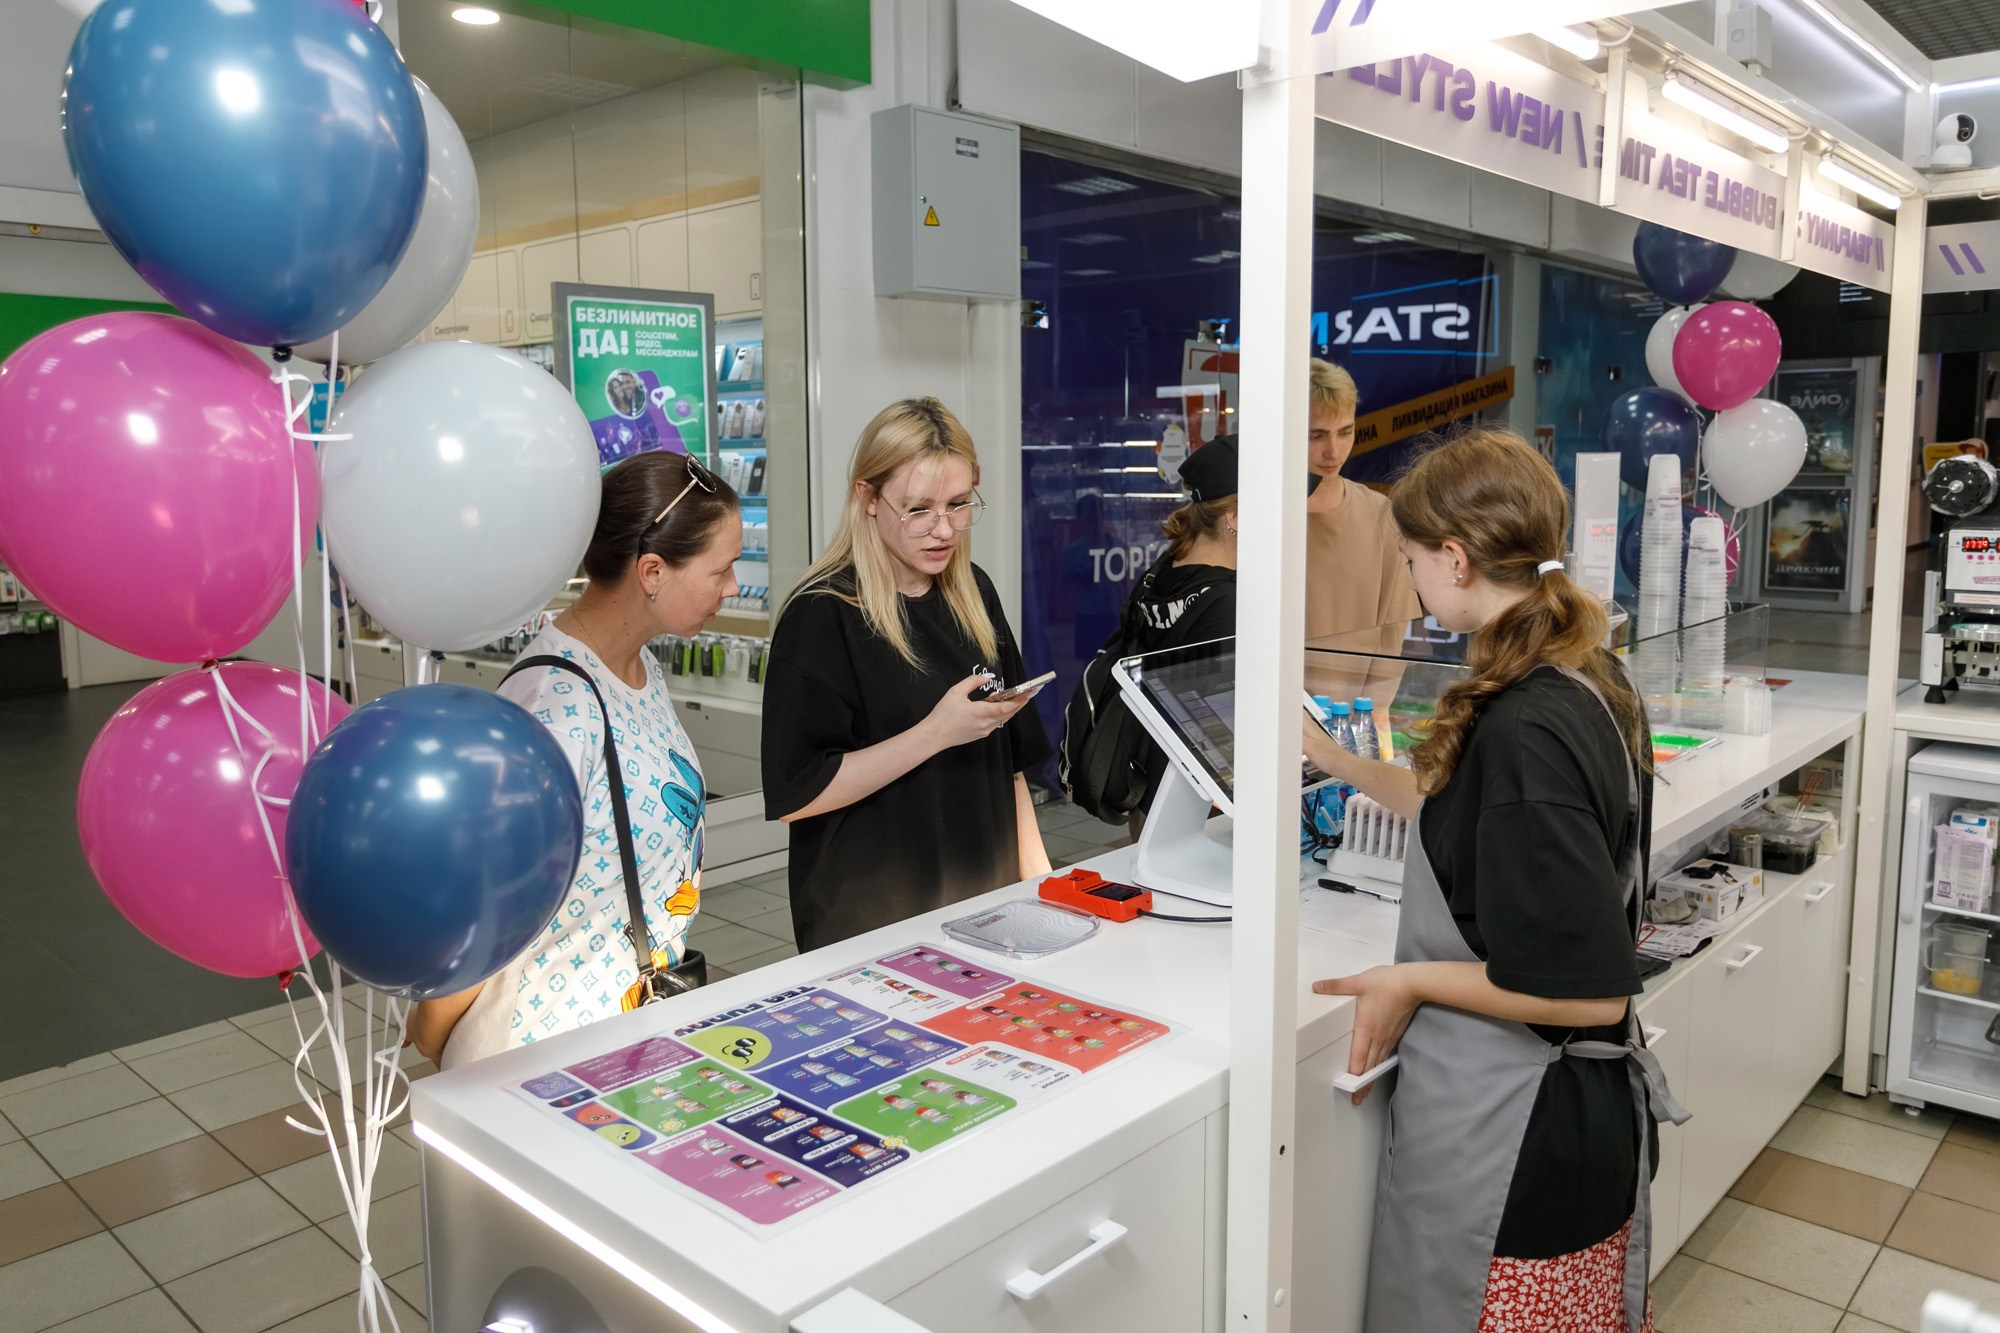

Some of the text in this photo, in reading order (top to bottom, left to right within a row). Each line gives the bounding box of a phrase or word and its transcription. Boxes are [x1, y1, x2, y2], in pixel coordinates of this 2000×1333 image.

[575, 306, 697, 329] БЕЗЛИМИТНОЕ
[578, 328, 629, 359] ДА!
[635, 330, 679, 341] СОЦСЕТЯМ,
[635, 339, 662, 349] ВИДЕО,
[635, 347, 699, 358] МЕССЕНДЖЕРАМ
[1391, 377, 1508, 433] ЛИКВИДАЦИЯ МАГАЗИНА
[763, 985, 817, 1004] TEA
[905, 1056, 936, 1070] МИЛКШЕЙК
[1041, 1073, 1069, 1088] МОЛОЧНЫЙ
[972, 1104, 1004, 1121] АЗИАТСКИЙ
[863, 1154, 902, 1174] БРАУН ШУГА
[794, 1196, 814, 1207] КОФЕ
